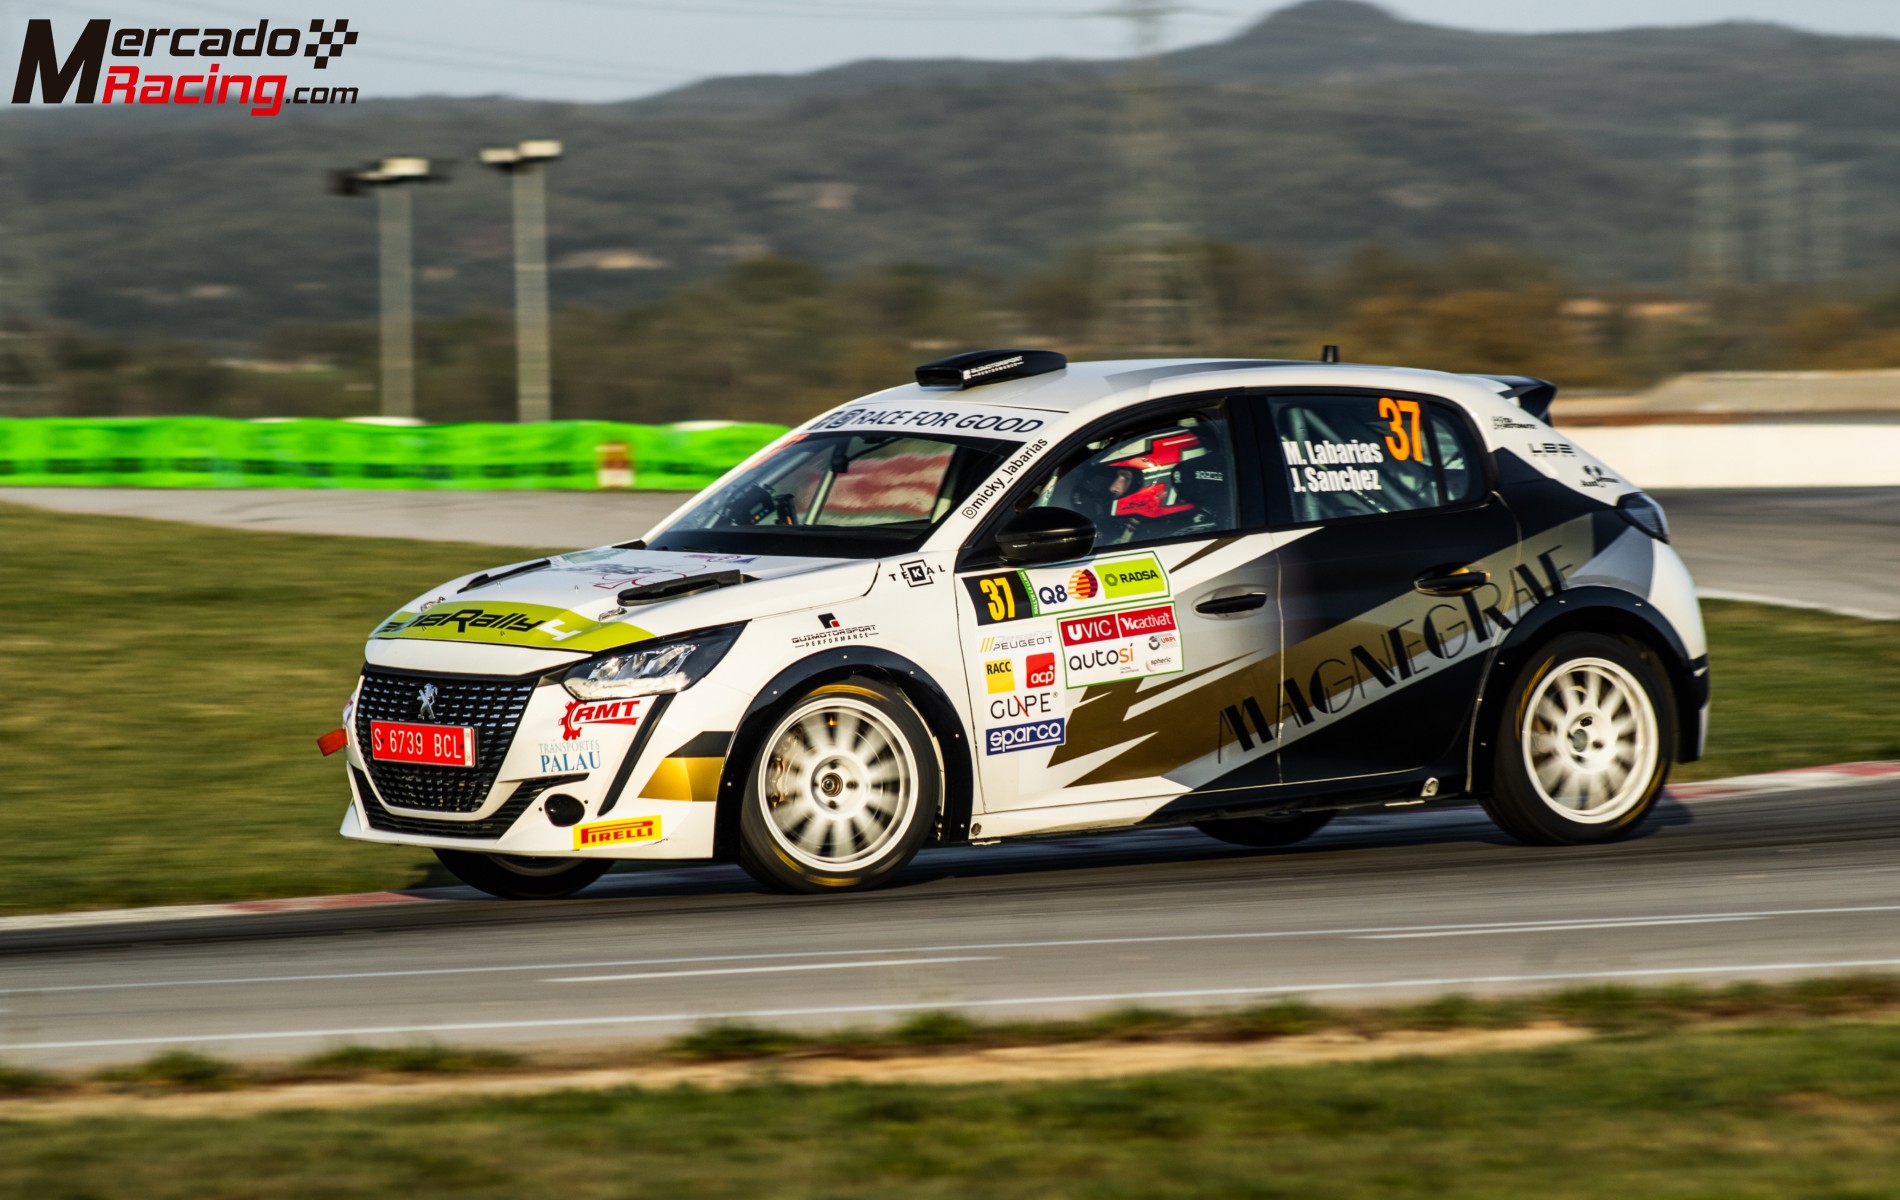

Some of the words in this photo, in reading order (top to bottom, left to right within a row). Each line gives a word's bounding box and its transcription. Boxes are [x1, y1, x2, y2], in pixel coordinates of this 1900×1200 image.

[851, 410, 912, 426] RACE
[905, 410, 960, 428] FOR
[955, 414, 1045, 434] GOOD
[1378, 397, 1424, 463] 37
[1281, 440, 1308, 465] M.
[1304, 439, 1384, 465] Labarias
[1290, 467, 1307, 492] J.
[1304, 466, 1382, 492] Sanchez
[888, 564, 946, 583] TEKAL
[1120, 569, 1159, 584] RADSA
[979, 576, 1016, 621] 37
[1038, 584, 1068, 606] Q8
[804, 632, 870, 649] PERFORMANCE
[1067, 619, 1113, 641] UVIC
[993, 636, 1053, 652] PEUGEOT
[986, 661, 1012, 676] RACC
[1030, 666, 1055, 685] acp
[374, 727, 382, 752] S
[389, 729, 424, 756] 6739
[433, 733, 462, 760] BCL
[538, 739, 600, 755] TRANSPORTES
[989, 721, 1062, 752] sparco
[540, 751, 601, 774] PALAU
[580, 820, 654, 845] PIRELLI
